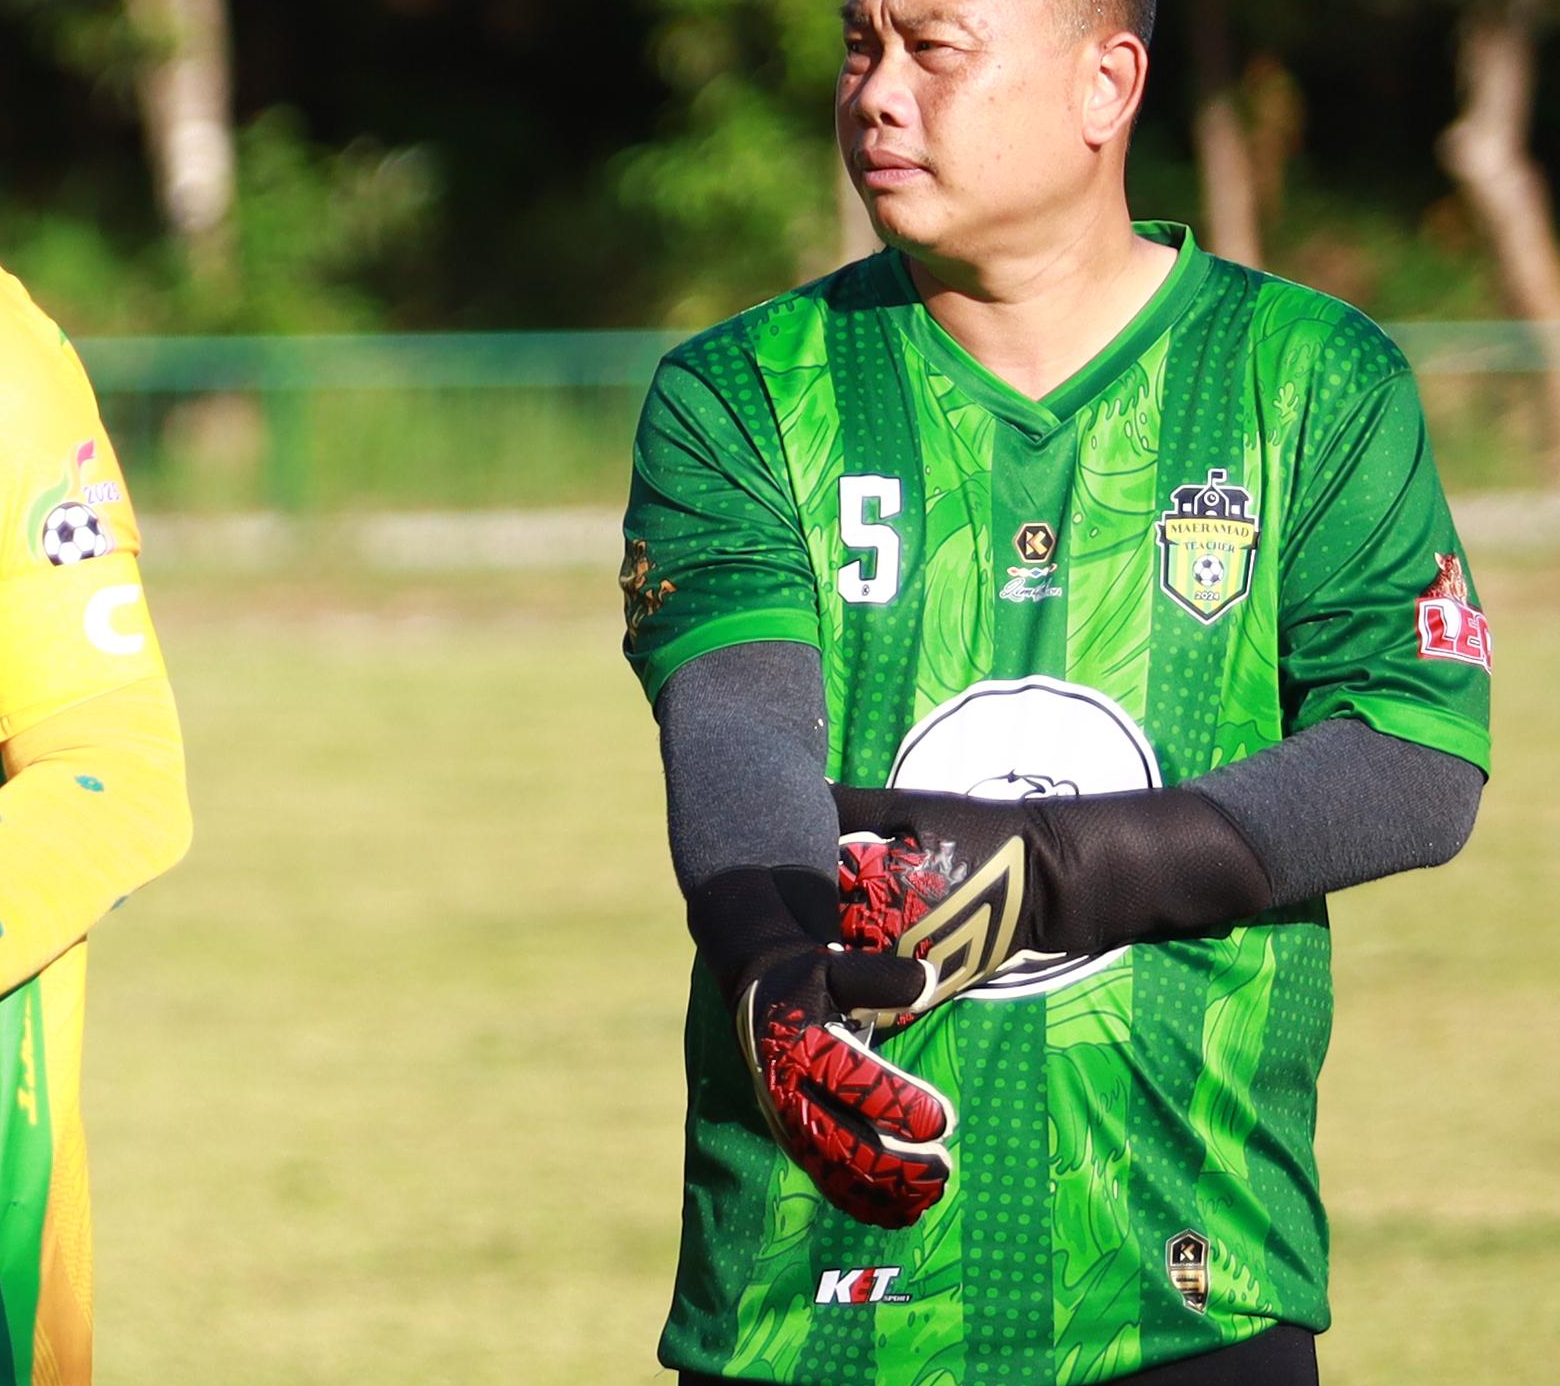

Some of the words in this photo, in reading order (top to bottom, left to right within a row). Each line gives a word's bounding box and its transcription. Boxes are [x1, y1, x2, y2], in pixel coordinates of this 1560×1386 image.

[1170, 522, 1250, 538] MAERAMAD
[1184, 541, 1236, 553] TEACHER
[84, 584, 145, 655] C
